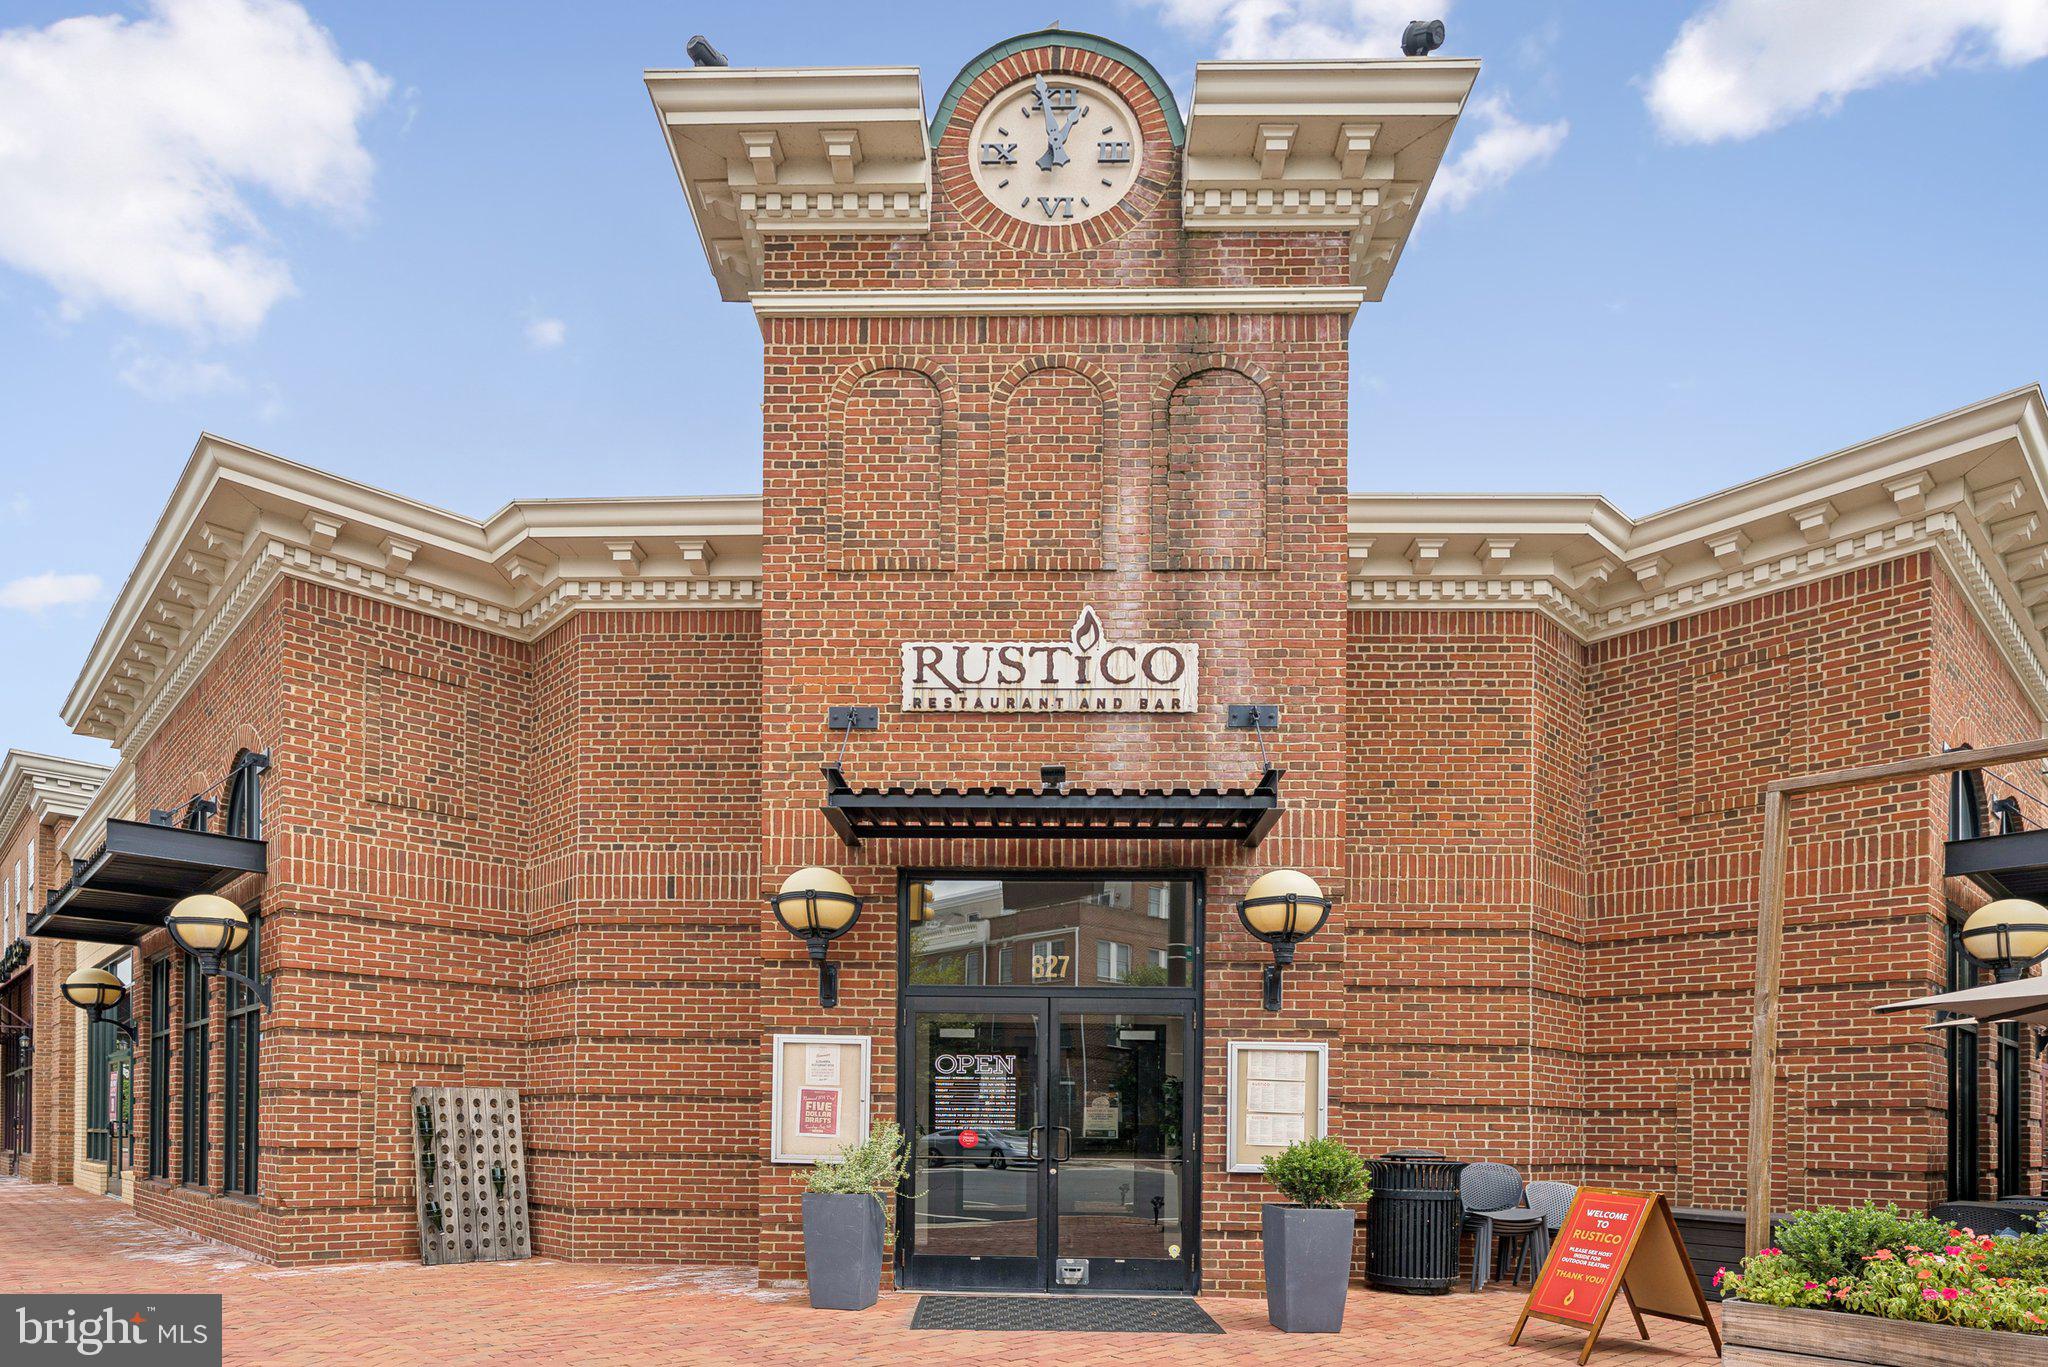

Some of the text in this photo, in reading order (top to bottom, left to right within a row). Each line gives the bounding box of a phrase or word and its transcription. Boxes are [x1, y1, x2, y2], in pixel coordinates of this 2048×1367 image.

[981, 143, 1017, 164] IX
[1098, 142, 1130, 163] III
[1037, 197, 1074, 218] VI
[912, 697, 1182, 710] RESTAURANT AND BAR
[1032, 954, 1069, 977] 827
[935, 1054, 1016, 1074] OPEN
[805, 1101, 832, 1112] FIVE
[1586, 1208, 1629, 1220] WELCOME
[1596, 1220, 1610, 1228] TO
[1573, 1229, 1622, 1245] RUSTICO
[1561, 1257, 1587, 1266] OUTDOOR
[1556, 1269, 1605, 1284] THANK YOU!
